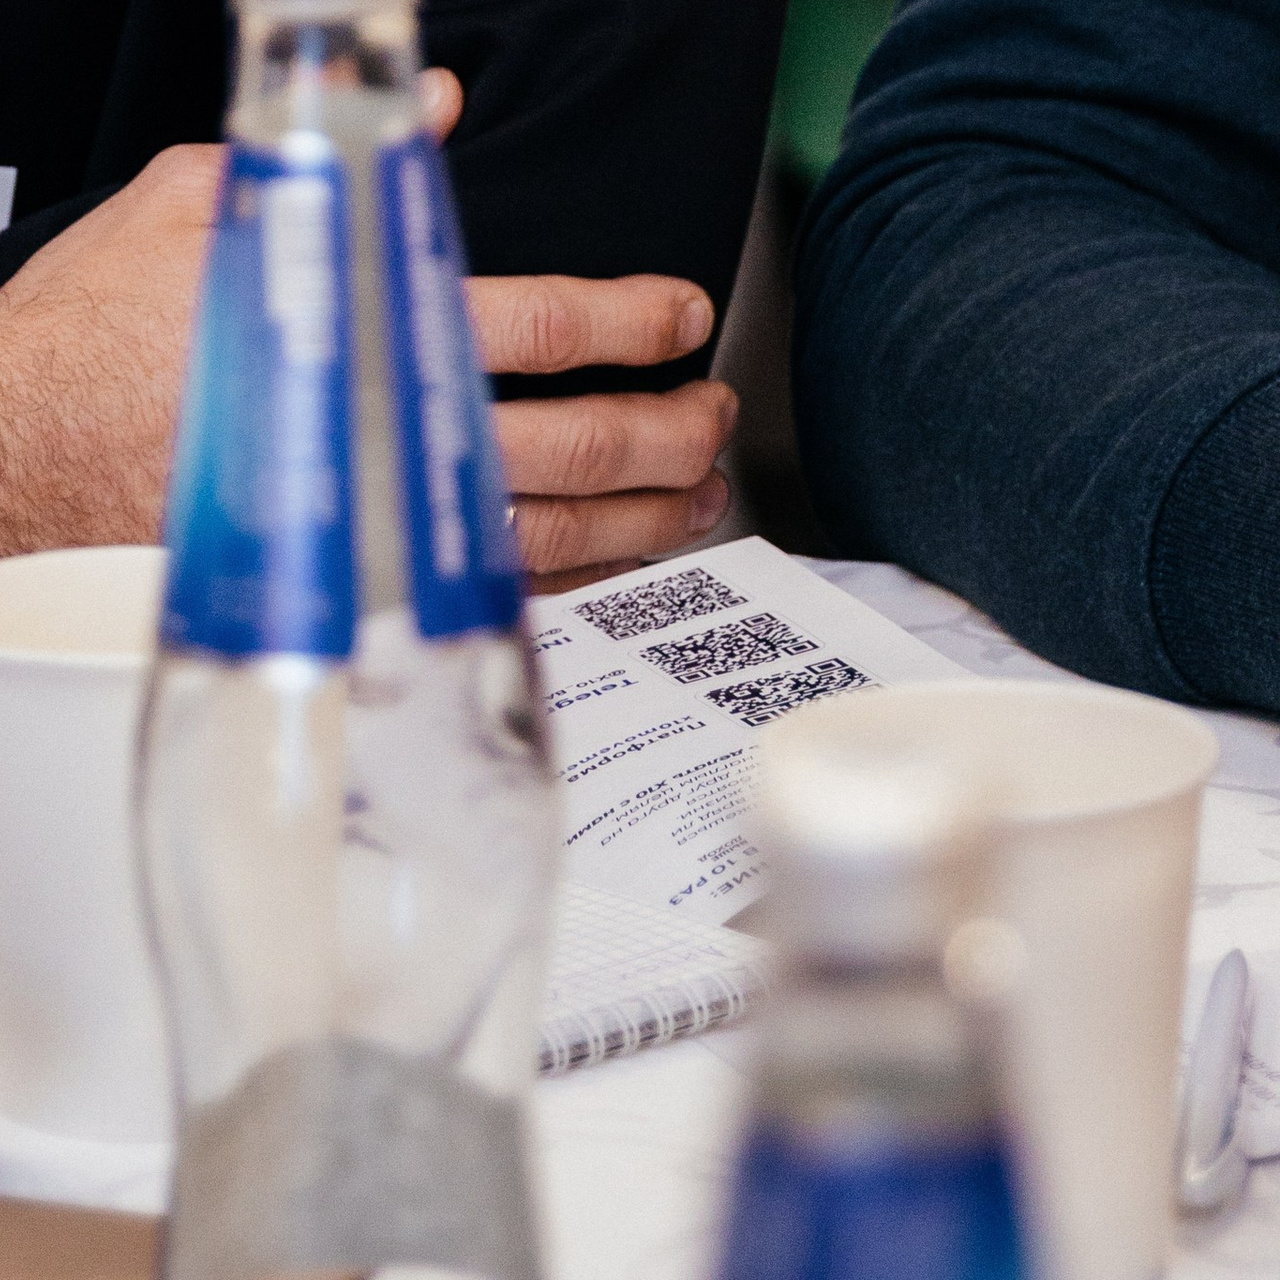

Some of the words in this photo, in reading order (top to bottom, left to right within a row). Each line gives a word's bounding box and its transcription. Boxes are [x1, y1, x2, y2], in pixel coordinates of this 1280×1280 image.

[566, 720, 708, 783] Платформа
[711, 859, 737, 876] 10
[668, 876, 709, 906] РАЗ
